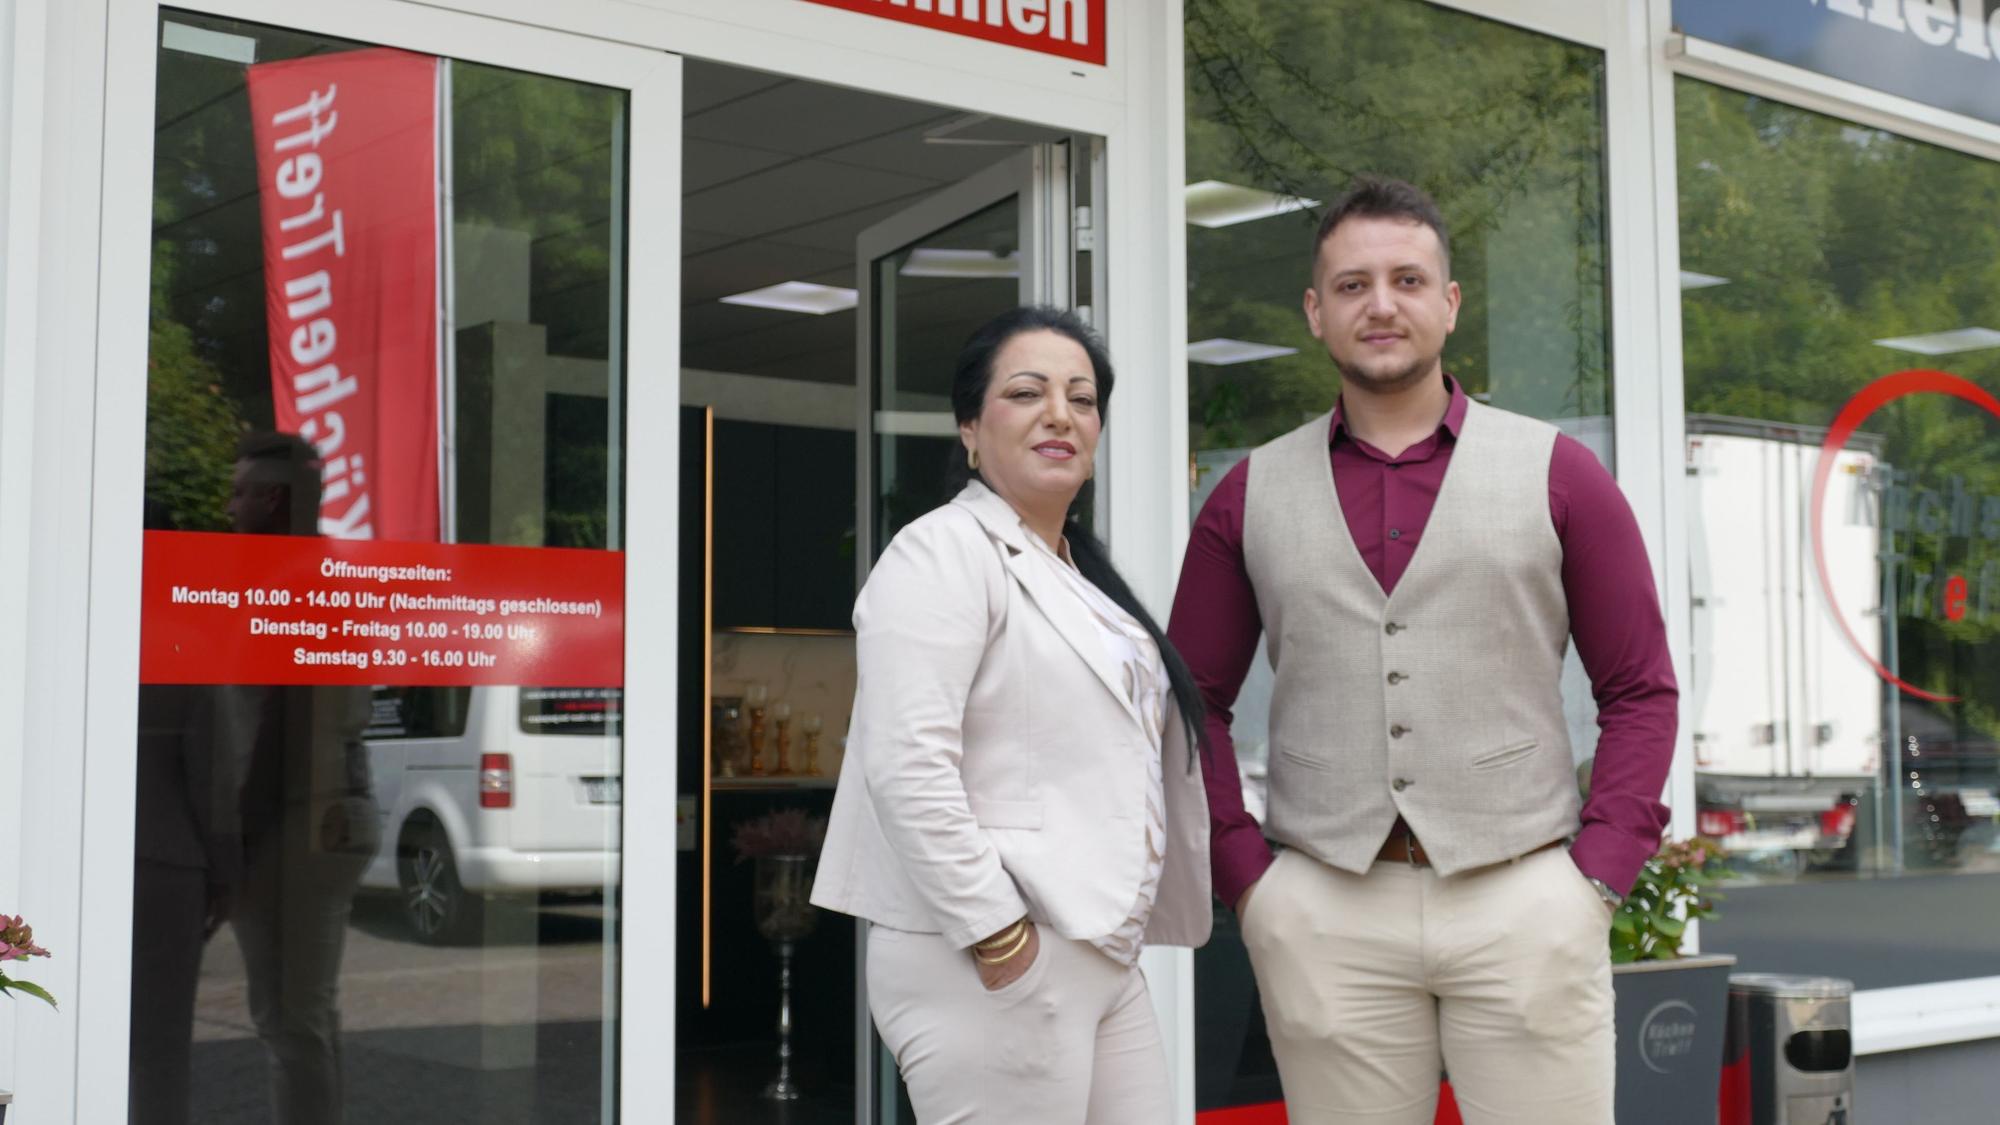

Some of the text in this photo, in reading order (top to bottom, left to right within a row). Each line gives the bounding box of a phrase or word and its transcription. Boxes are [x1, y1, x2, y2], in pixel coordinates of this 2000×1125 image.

[320, 558, 452, 583] Öffnungszeiten:
[172, 586, 240, 608] Montag
[244, 588, 291, 606] 10.00
[306, 590, 351, 608] 14.00
[355, 592, 386, 608] Uhr
[390, 593, 496, 615] (Nachmittags
[500, 598, 602, 619] geschlossen)
[250, 617, 328, 640] Dienstag
[342, 620, 401, 641] Freitag
[405, 622, 448, 639] 10.00
[462, 623, 503, 640] 19.00
[507, 625, 537, 641] Uhr
[293, 647, 369, 669] Samstag
[372, 649, 407, 667] 9.30
[421, 650, 463, 667] 16.00
[467, 651, 497, 667] Uhr
